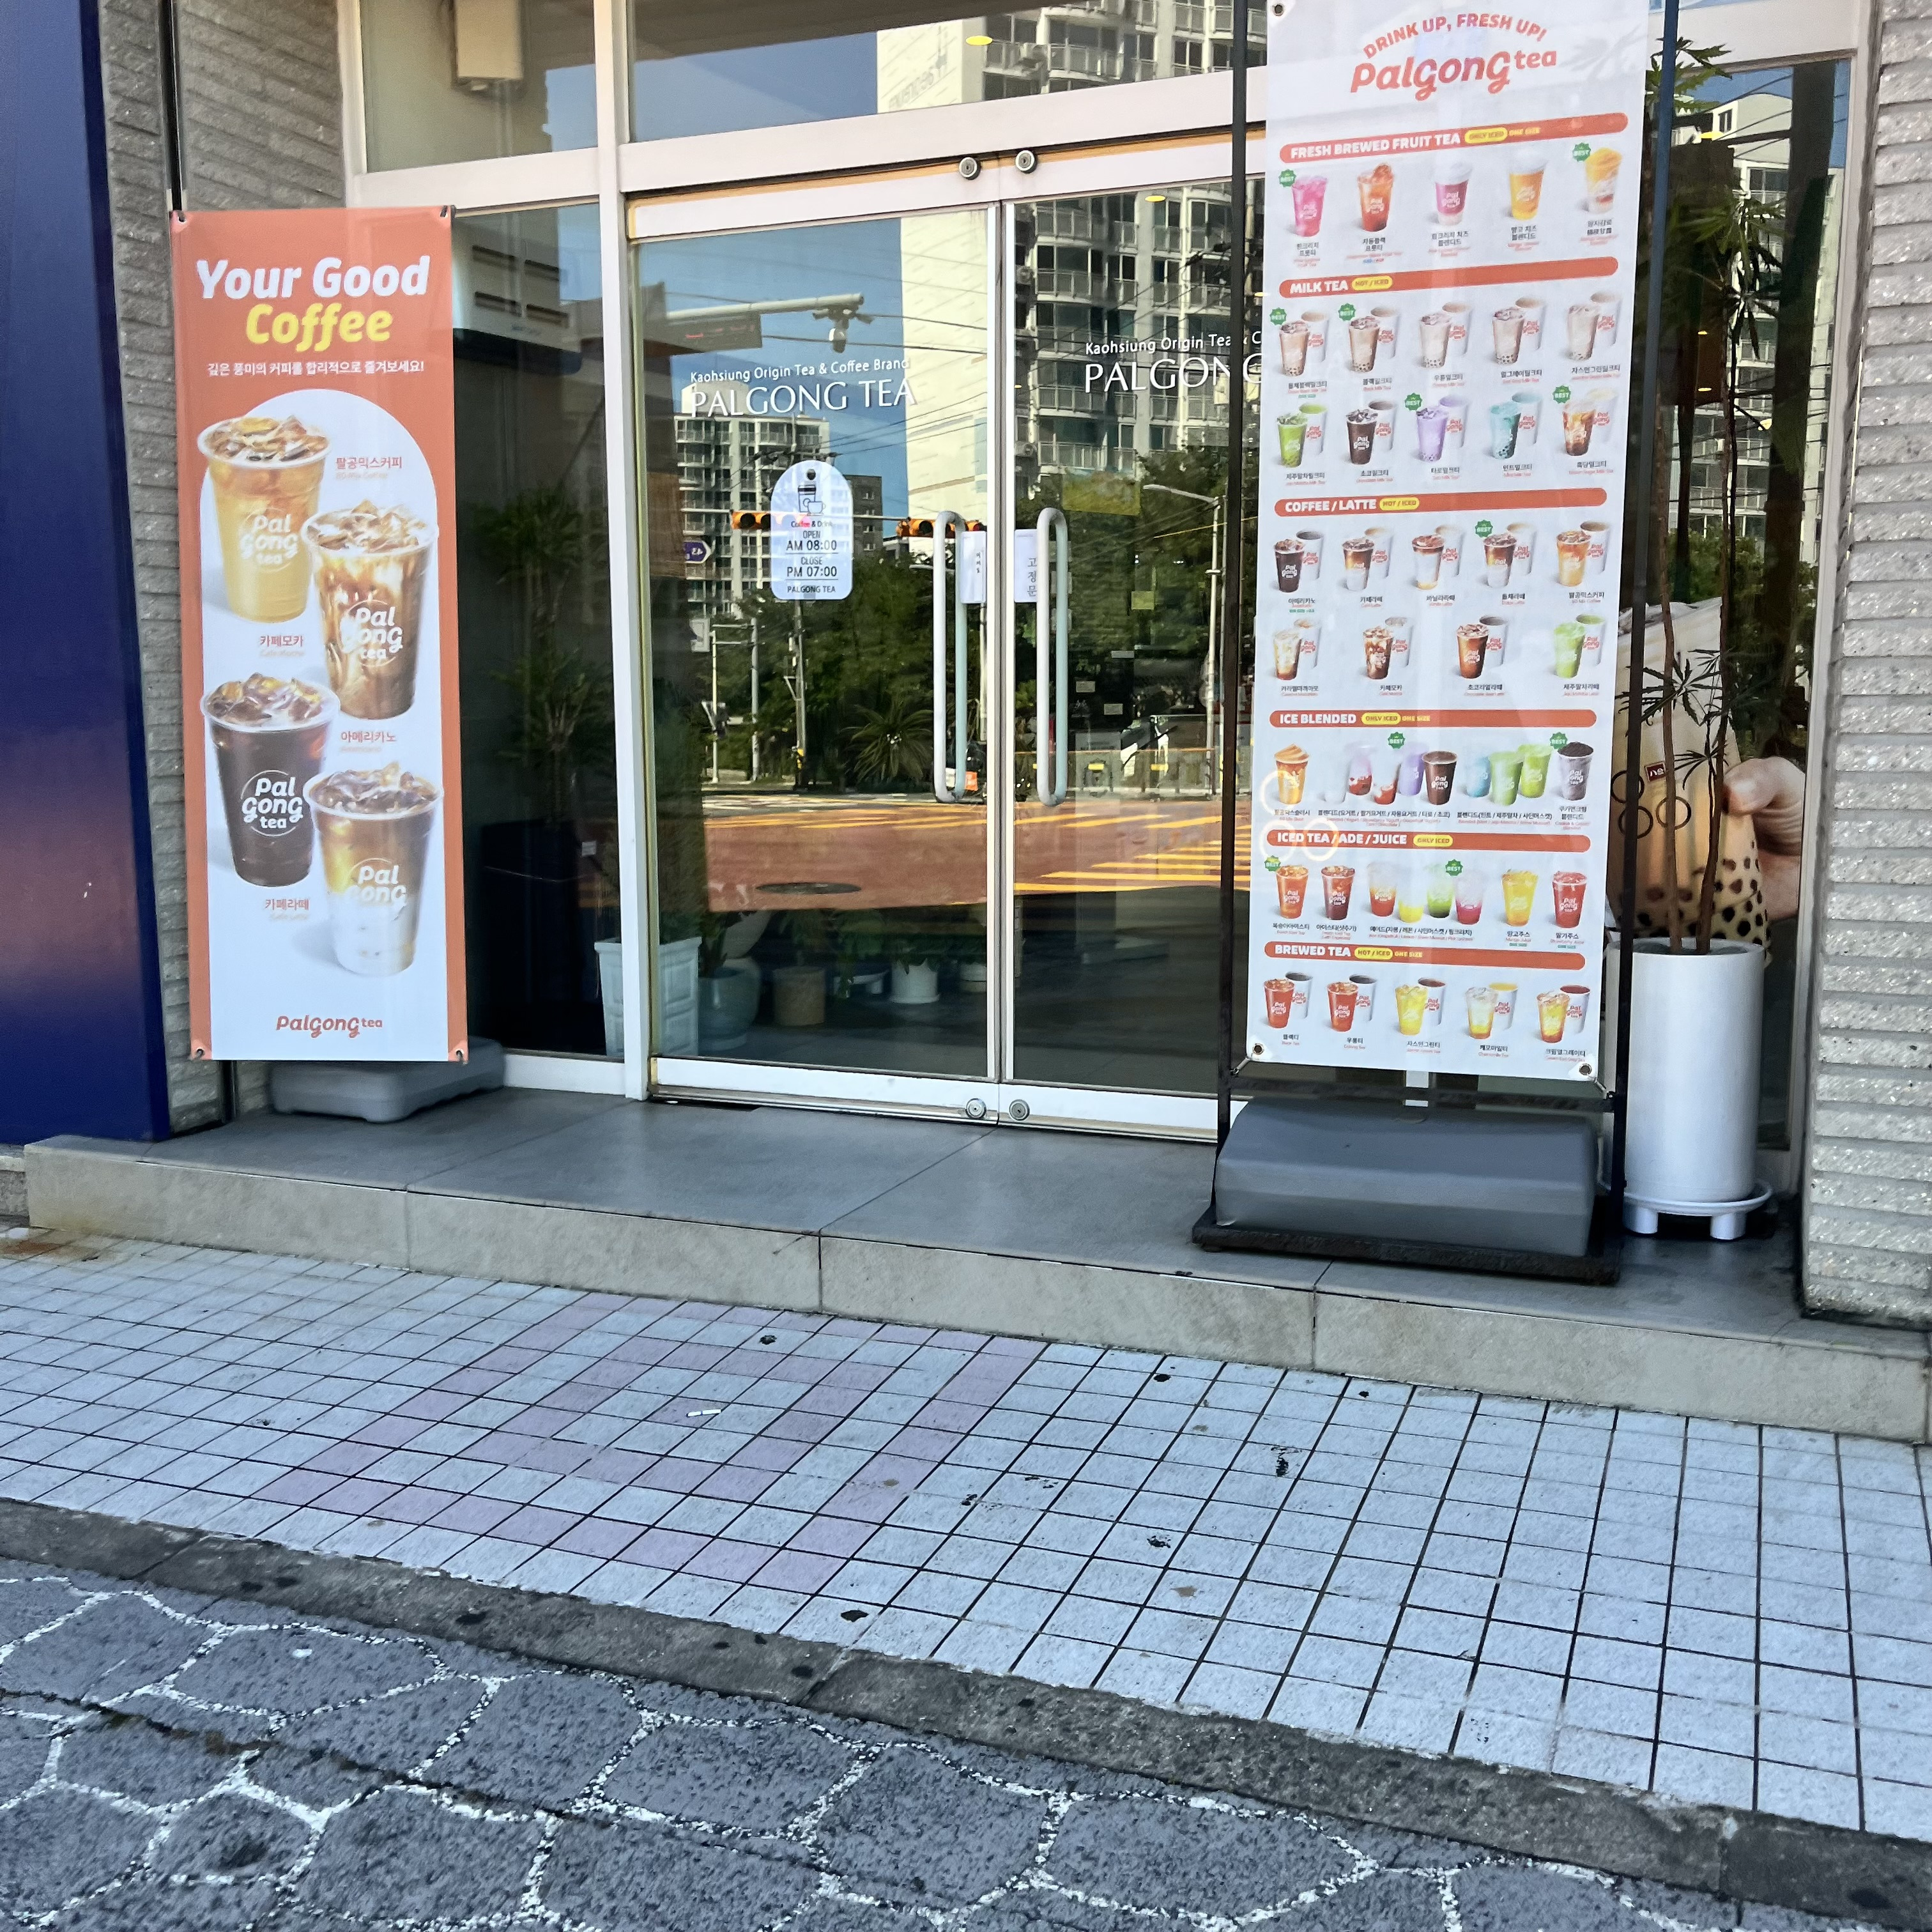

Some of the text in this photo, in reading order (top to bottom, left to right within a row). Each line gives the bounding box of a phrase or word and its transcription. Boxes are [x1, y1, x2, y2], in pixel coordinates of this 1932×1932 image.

[1362, 13, 1548, 59] DRINK UP, FRESH UP!
[1350, 50, 1558, 101] Palgong tea
[1291, 133, 1460, 159] FRESH BREWED FRUIT TEA
[196, 255, 430, 299] Your Good
[1289, 281, 1322, 294] MILK
[1324, 280, 1349, 292] TEA
[246, 303, 394, 352] Coffee
[1085, 334, 1230, 355] Kaohsiung Origin Tea
[208, 360, 424, 376] 깊은 풍미의 커피를 합리적으로 즐겨보세요!
[691, 358, 910, 383] Kaohsiung Origin Tea & Coffee Brand
[691, 378, 918, 418] PALGONG TEA
[336, 457, 402, 469] 팔공믹스커피
[1285, 500, 1330, 512] COFFEE
[1338, 499, 1376, 510] LATTE
[253, 514, 291, 533] Pal
[803, 530, 820, 539] OPEN
[786, 540, 837, 550] AM 08:00
[801, 556, 822, 565] CLOSE
[787, 566, 837, 577] PM 07:00
[1027, 558, 1037, 597] 고정문
[355, 606, 395, 626] Pal
[260, 635, 303, 647] 카페모카
[1280, 714, 1298, 724] ICE
[1301, 714, 1356, 724] BLENDED
[341, 731, 397, 742] 아메리카노
[255, 777, 296, 796] Pal
[241, 797, 303, 823] gong
[259, 816, 287, 829] tea
[1277, 832, 1304, 843] ICED
[1307, 832, 1330, 843] TEA
[1338, 833, 1363, 844] ADE
[1372, 834, 1407, 845] JUICE
[358, 865, 399, 885] Pal
[1275, 944, 1326, 956] BREWED
[1328, 946, 1351, 957] TEA
[275, 1015, 383, 1038] Palgong tea
